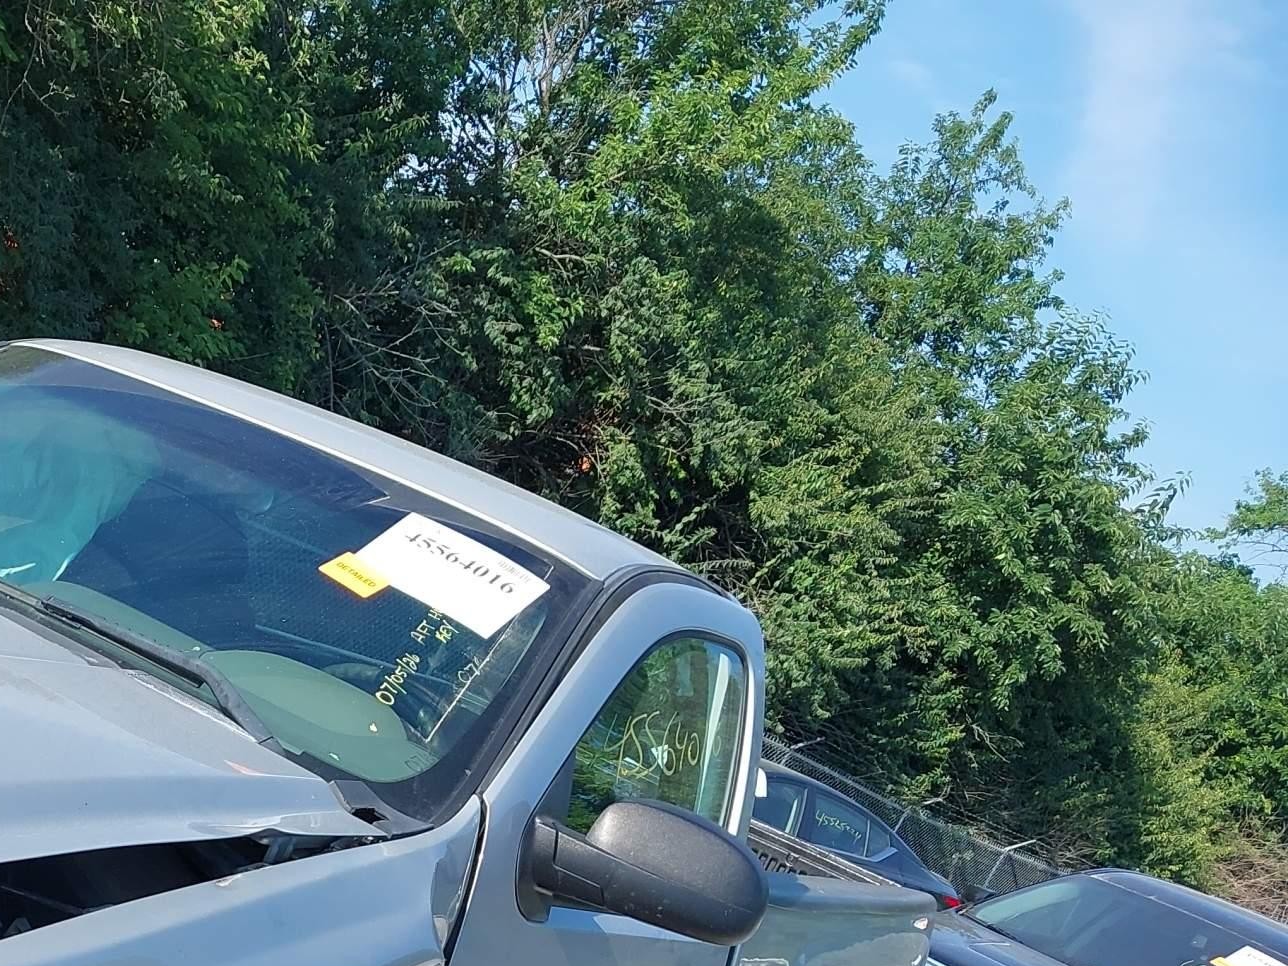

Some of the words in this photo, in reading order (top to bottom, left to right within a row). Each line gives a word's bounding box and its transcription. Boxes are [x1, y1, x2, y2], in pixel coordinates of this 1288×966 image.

[335, 560, 377, 588] DETAILED
[404, 531, 515, 596] 45564016
[434, 619, 460, 644] KEY
[375, 653, 421, 706] 07/05/26
[410, 619, 435, 646] AFT
